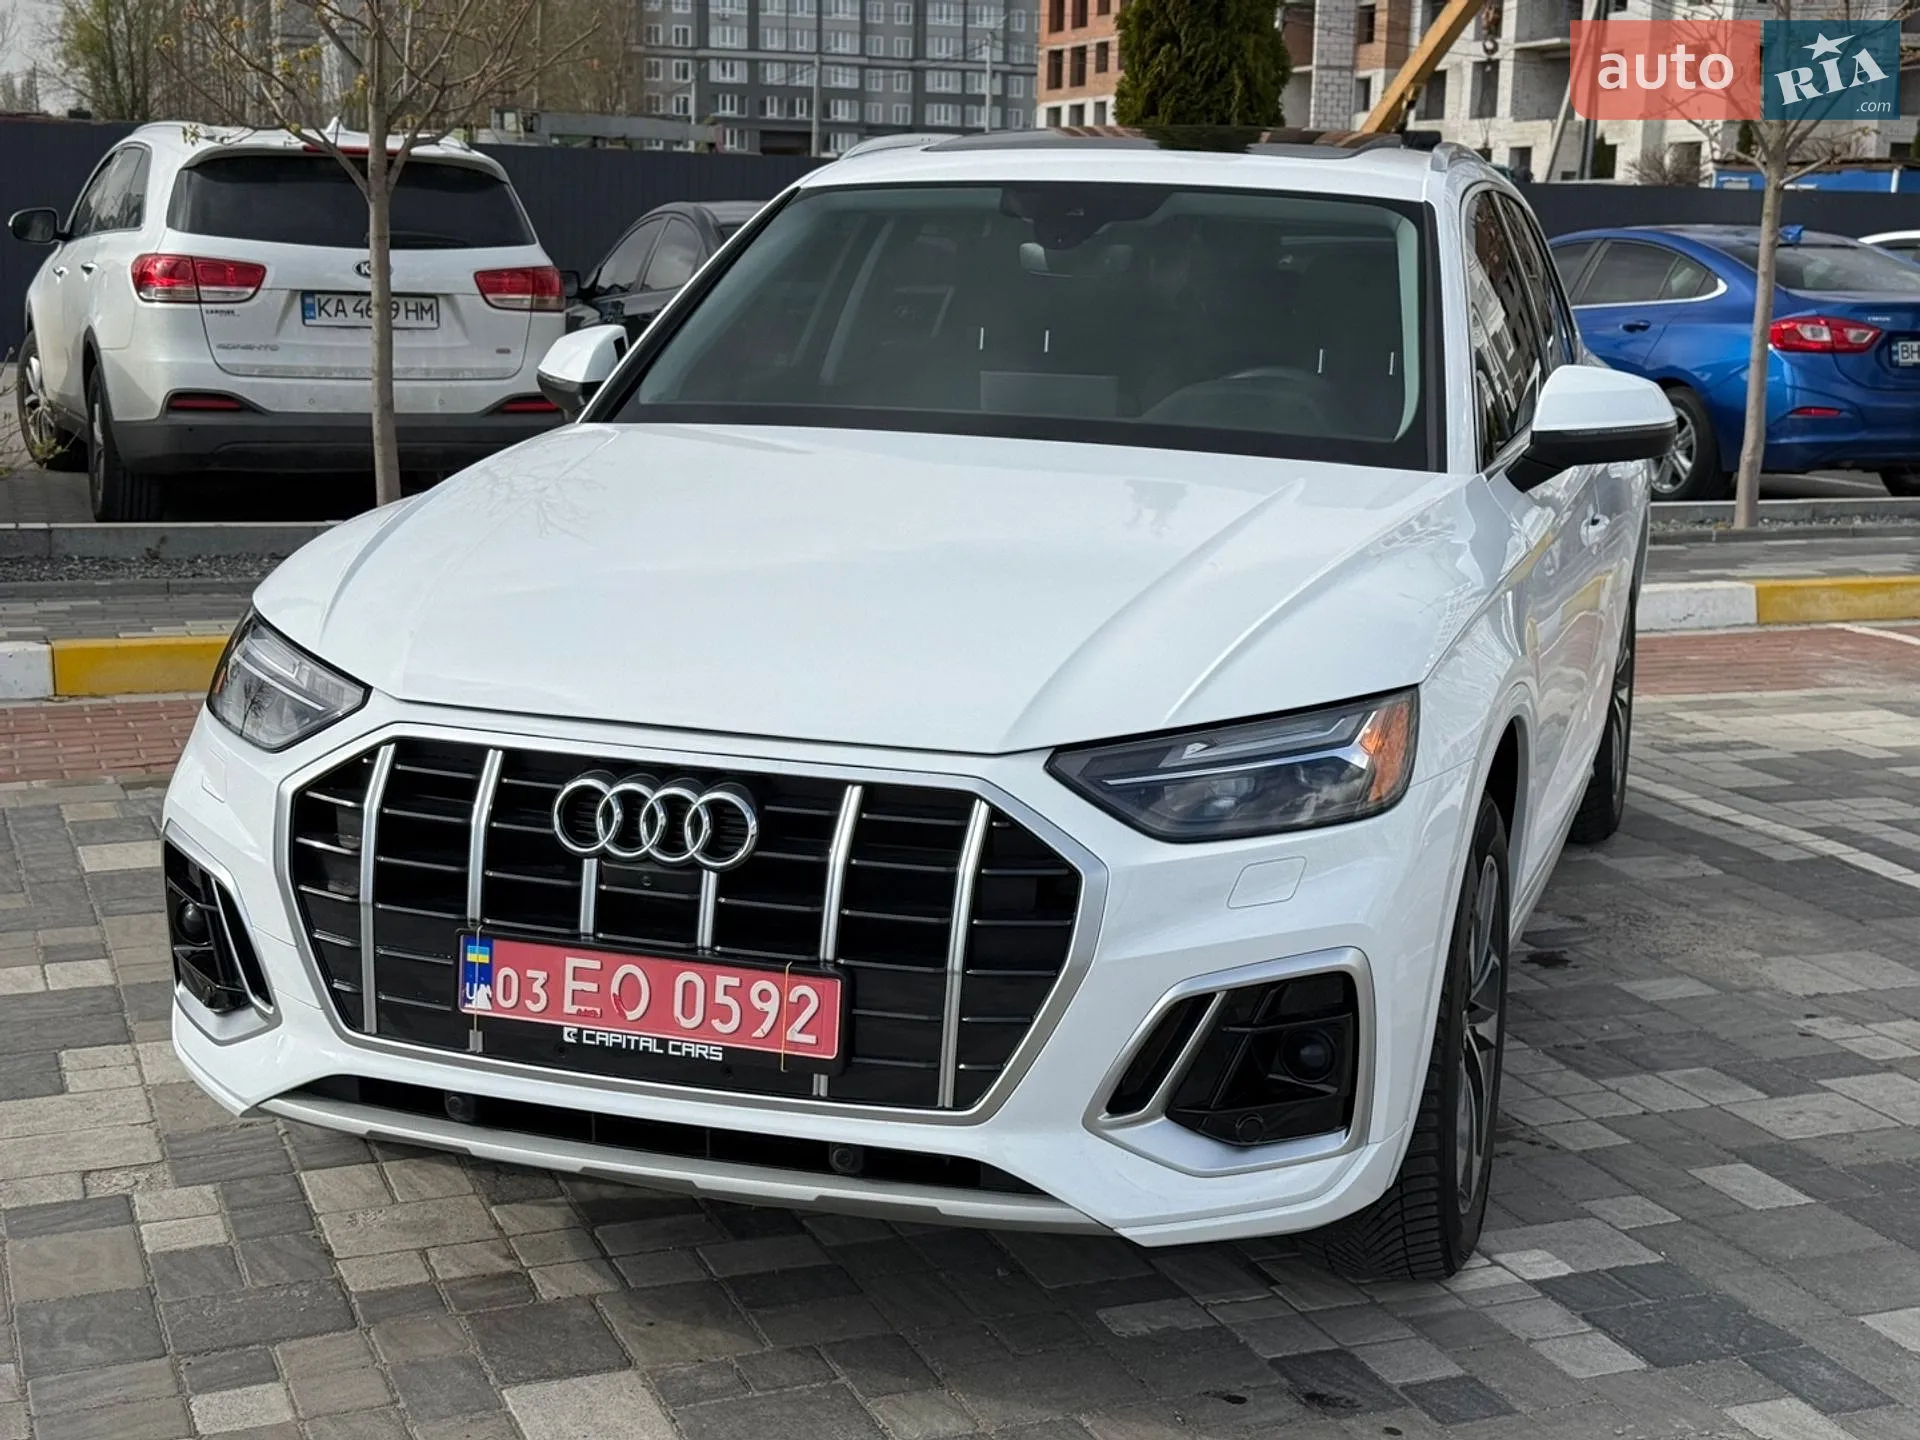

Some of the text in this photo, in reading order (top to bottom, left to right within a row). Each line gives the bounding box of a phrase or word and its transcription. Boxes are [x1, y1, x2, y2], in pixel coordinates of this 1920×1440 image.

[317, 298, 435, 321] KA 469 HM
[496, 956, 820, 1045] 03 EO 0592
[582, 1029, 724, 1062] CAPITAL CARS
